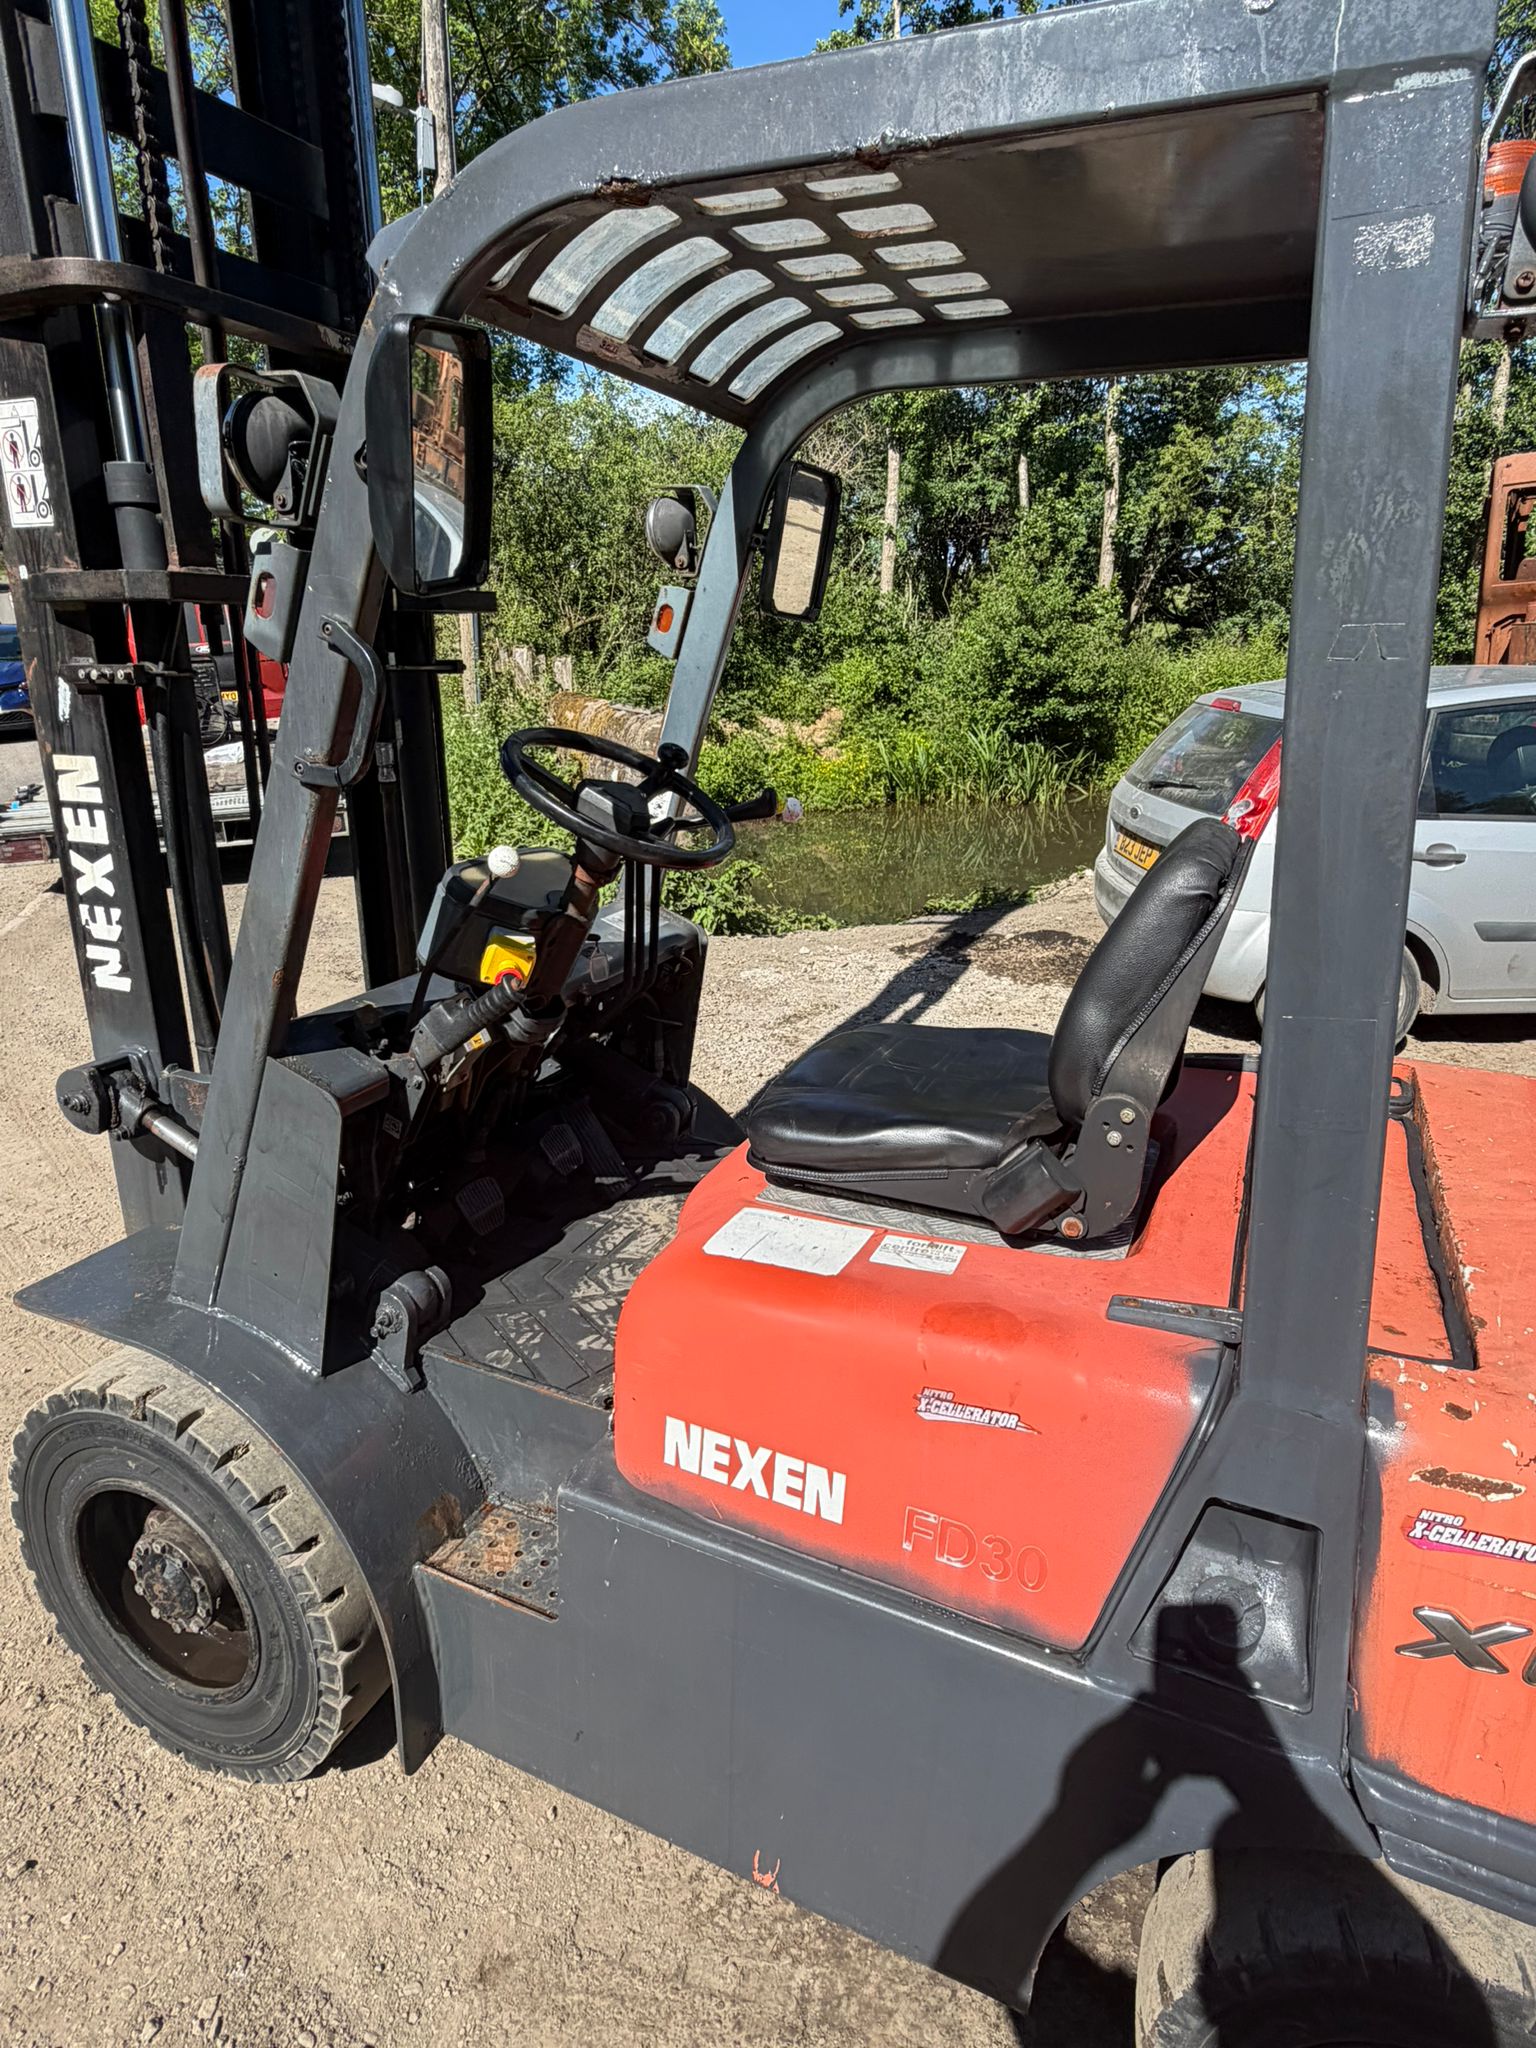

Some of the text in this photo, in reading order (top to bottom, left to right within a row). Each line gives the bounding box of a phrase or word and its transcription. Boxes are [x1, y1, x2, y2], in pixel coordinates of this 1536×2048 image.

[52, 754, 132, 993] NEXEN
[882, 1242, 929, 1254] centre
[917, 1397, 1020, 1430] X-CELLERATOR
[922, 1387, 955, 1401] NITRO
[663, 1415, 847, 1526] NEXEN
[1418, 1509, 1465, 1527] NITRO
[901, 1505, 1049, 1593] FD30
[1395, 1605, 1536, 1687] X
